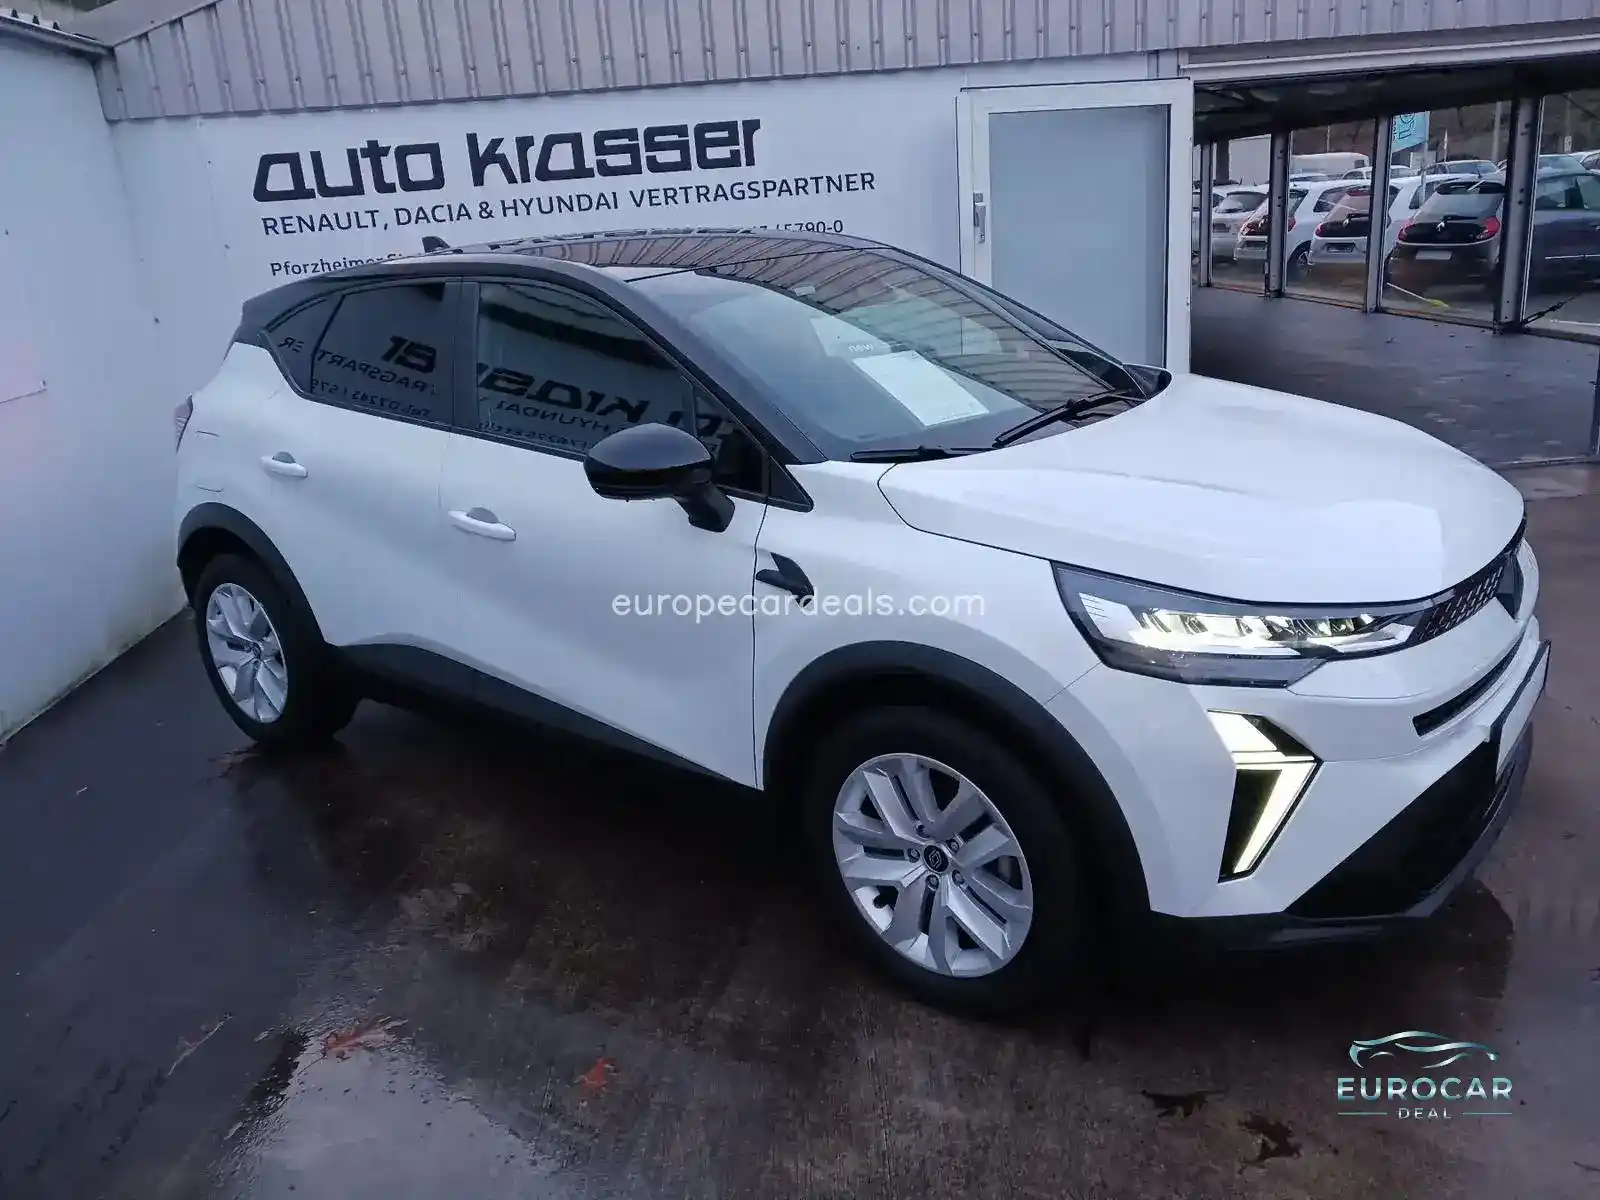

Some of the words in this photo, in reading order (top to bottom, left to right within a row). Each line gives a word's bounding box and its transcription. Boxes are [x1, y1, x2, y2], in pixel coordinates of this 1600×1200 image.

[262, 209, 388, 236] RENAULT,
[395, 201, 472, 226] DACIA
[478, 201, 494, 219] &
[501, 191, 618, 217] HYUNDAI
[626, 172, 876, 208] VERTRAGSPARTNER
